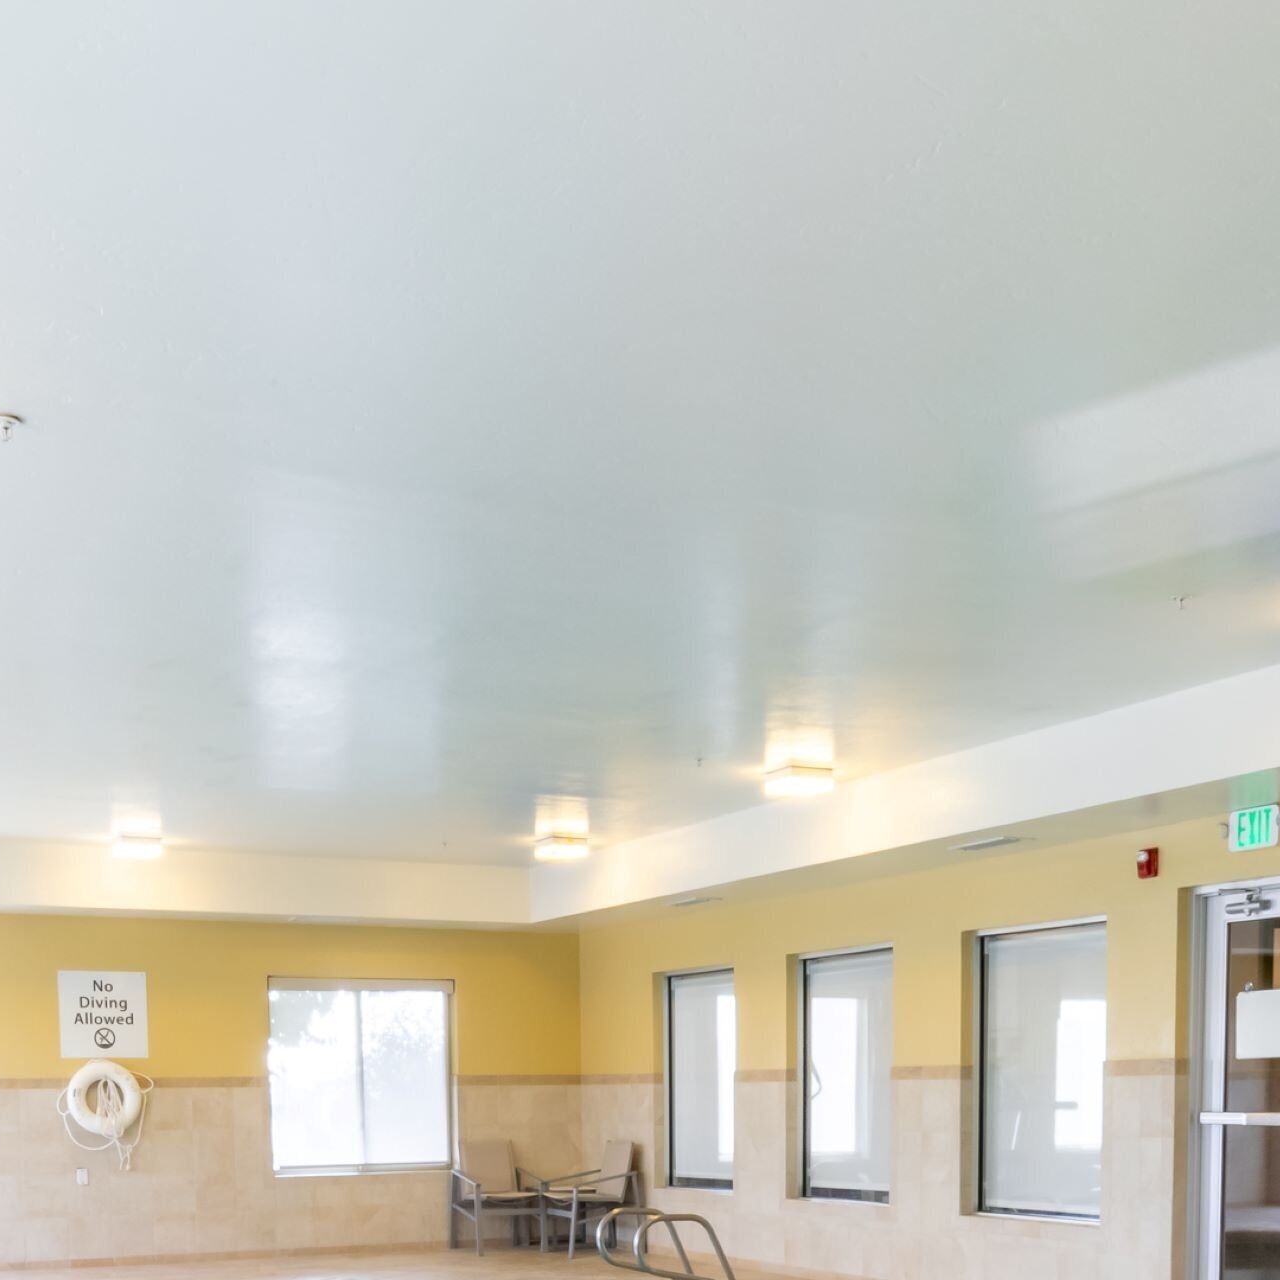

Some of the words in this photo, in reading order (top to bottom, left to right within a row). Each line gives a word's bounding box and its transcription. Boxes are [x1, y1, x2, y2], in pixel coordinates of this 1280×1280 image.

[1237, 807, 1272, 847] EXIT
[93, 979, 114, 992] No
[79, 996, 128, 1012] Diving
[74, 1012, 134, 1025] Allowed
